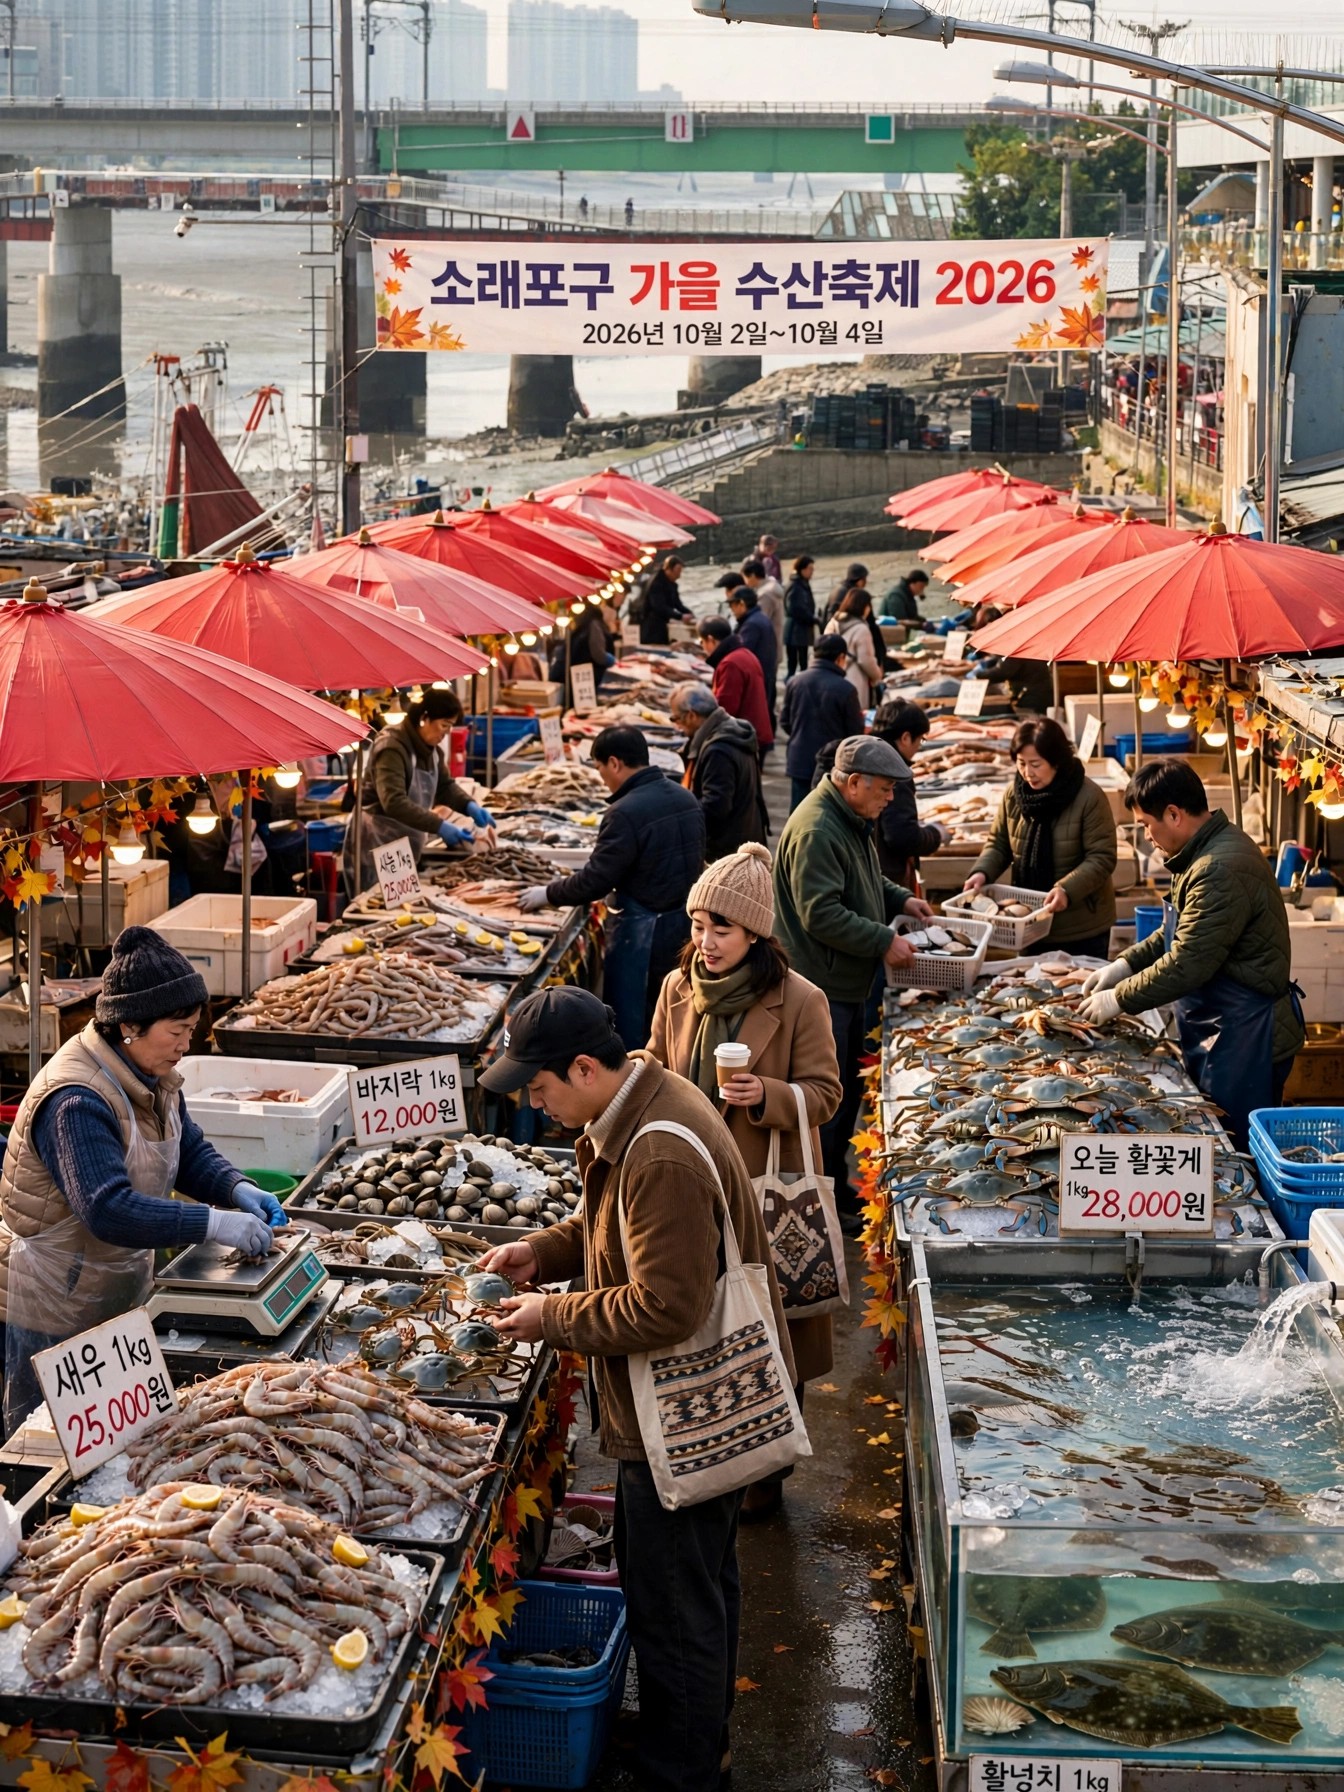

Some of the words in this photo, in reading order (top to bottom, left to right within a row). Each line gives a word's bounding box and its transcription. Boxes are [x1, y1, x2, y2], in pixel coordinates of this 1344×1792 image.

[430, 260, 615, 310] 소래포구
[629, 261, 721, 311] 가을
[735, 259, 920, 310] 수산축제
[935, 259, 1056, 305] 2026
[583, 321, 664, 346] 2026년
[673, 321, 723, 346] 10월
[730, 320, 838, 346] 2일~10월
[845, 320, 884, 345] 4일
[356, 1068, 423, 1102] 바지락
[429, 1070, 456, 1090] 1kg
[361, 1098, 458, 1135] 12,000원
[1070, 1143, 1120, 1175] 오늘
[1127, 1143, 1201, 1176] 활꽃게
[1066, 1180, 1089, 1199] 1kg
[1081, 1188, 1206, 1222] 28,000원
[55, 1343, 106, 1398] 새우
[112, 1334, 152, 1372] 1kg
[67, 1372, 173, 1458] 25,000원
[1074, 1768, 1109, 1792] 1kg
